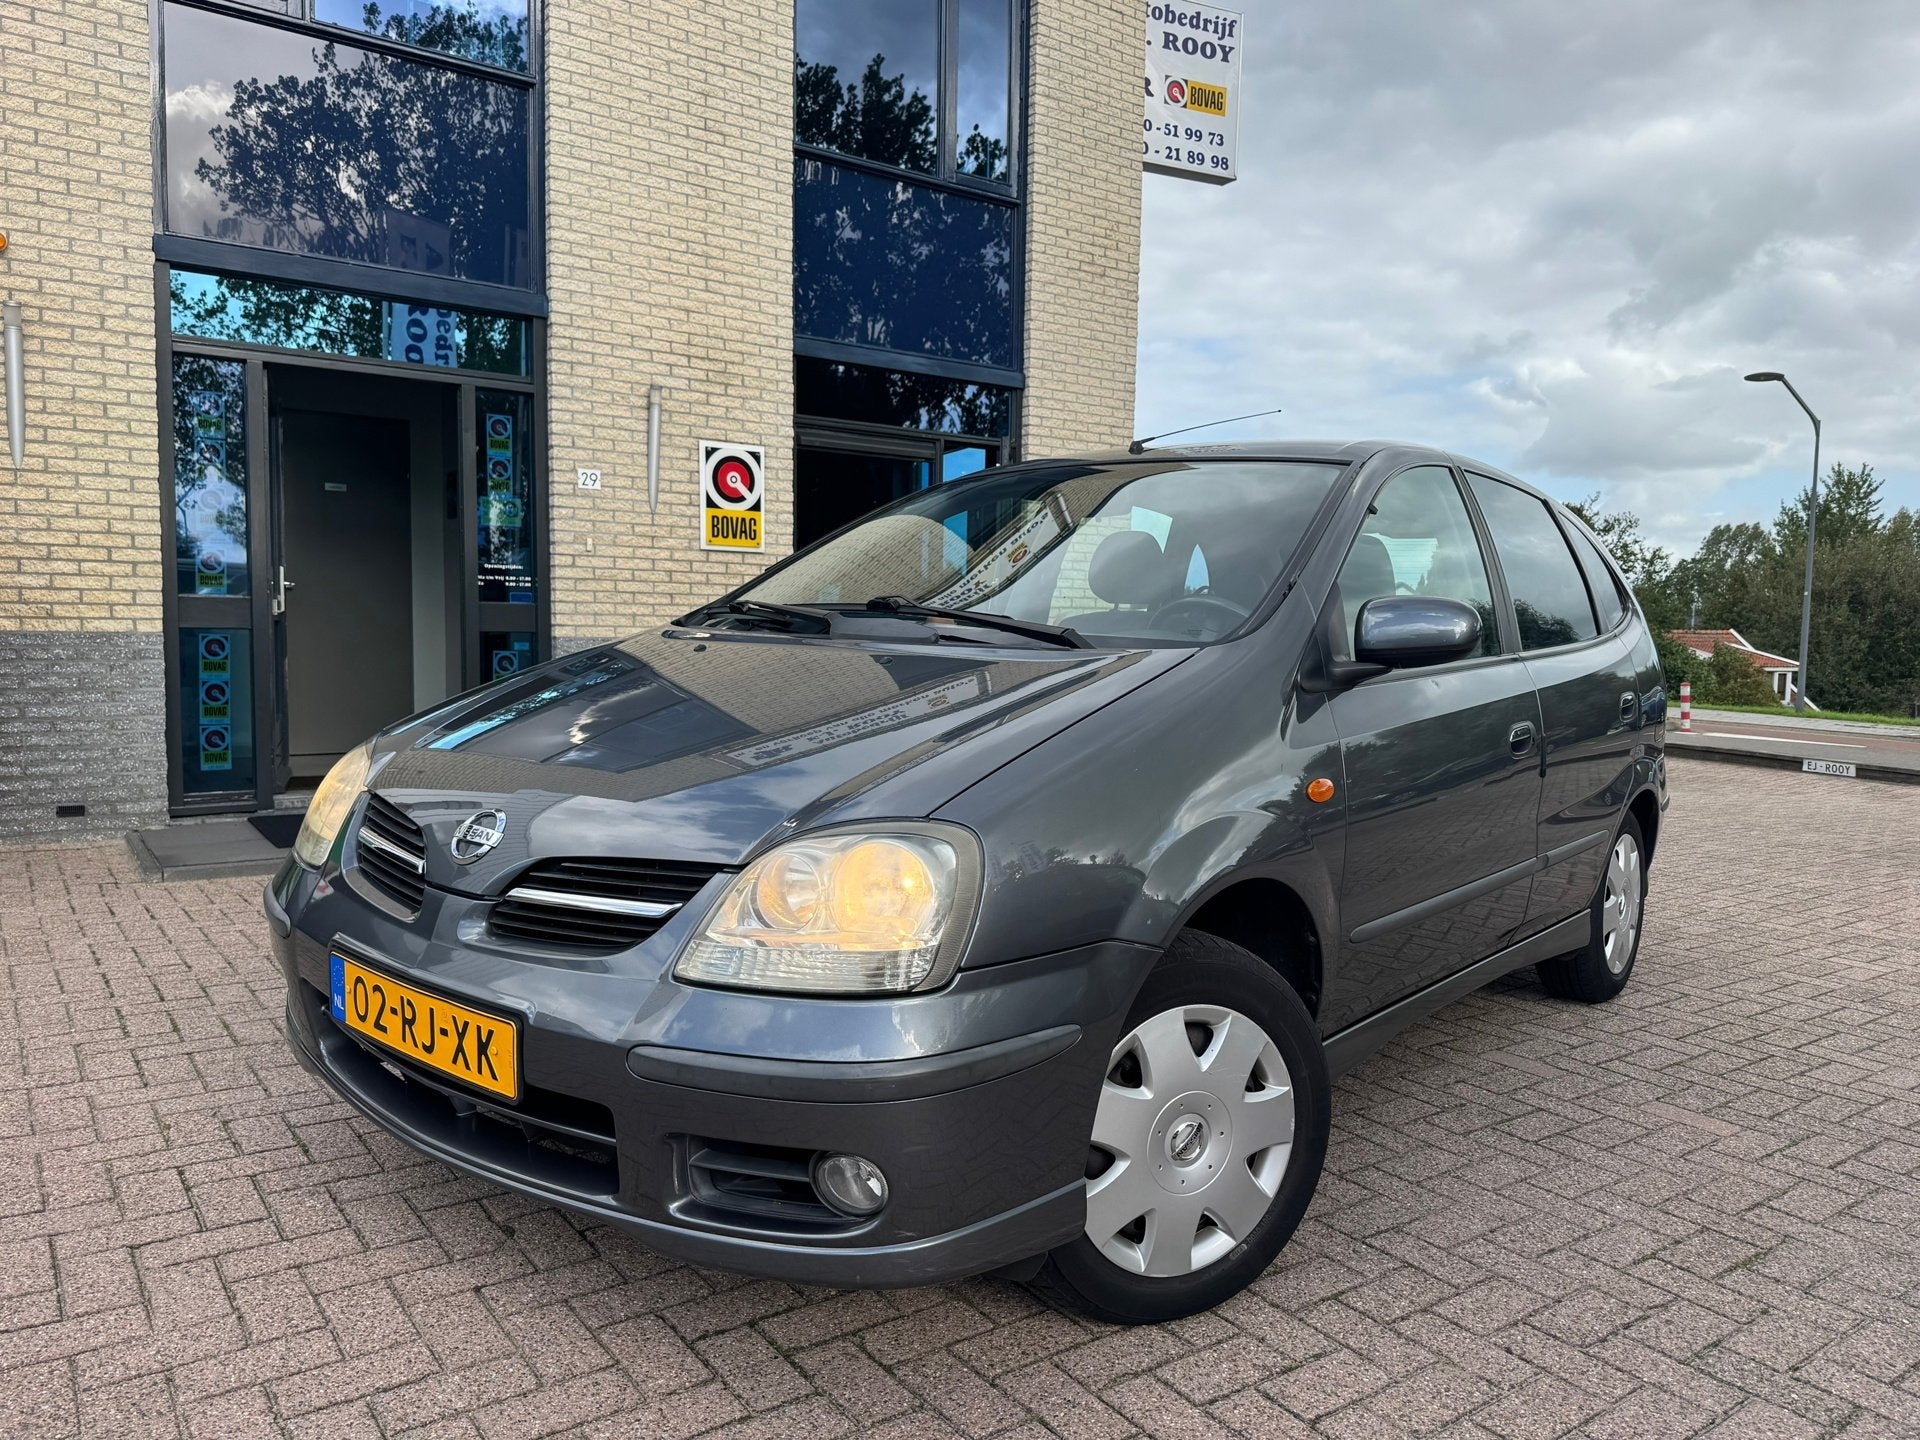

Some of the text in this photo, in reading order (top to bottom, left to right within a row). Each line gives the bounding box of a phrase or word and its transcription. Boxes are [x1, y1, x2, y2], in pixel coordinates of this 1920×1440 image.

[1162, 31, 1235, 63] ROOY
[1190, 86, 1224, 111] BOVAG
[1164, 123, 1180, 138] 51
[1184, 130, 1203, 142] 99
[1208, 132, 1224, 146] 73
[1166, 146, 1182, 162] 21
[1188, 151, 1205, 166] 89
[1210, 156, 1229, 170] 98
[581, 472, 598, 486] 29
[712, 515, 756, 541] BOVAG
[200, 574, 223, 586] BOVAG
[203, 661, 227, 672] BOVAG
[204, 706, 228, 718] BOVAG
[204, 752, 228, 763] BOVAG
[1807, 761, 1817, 770] EJ
[1825, 764, 1851, 774] ROOY
[334, 994, 344, 1010] NL
[353, 975, 499, 1082] 02-RJ-XK
